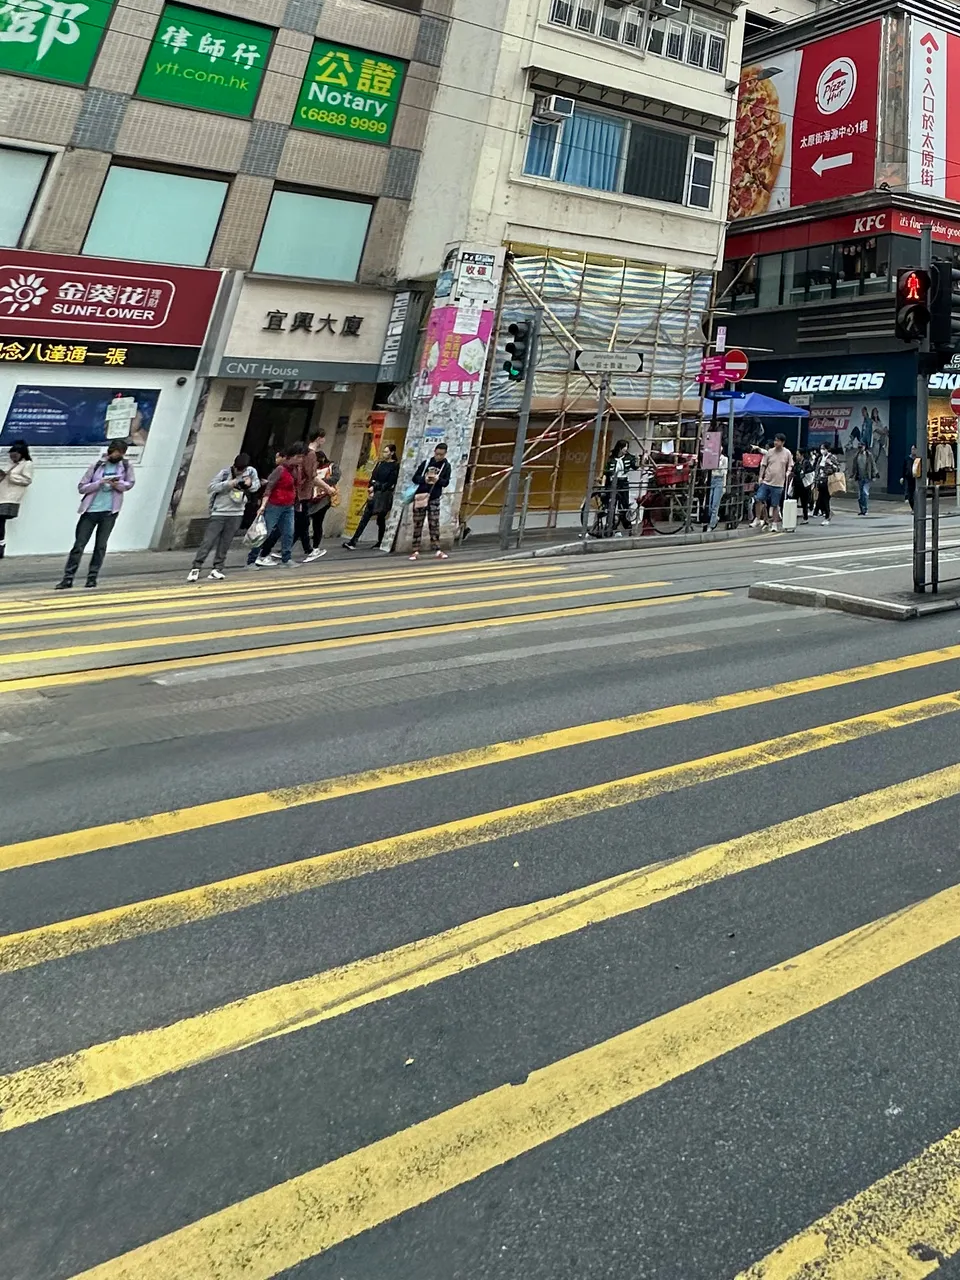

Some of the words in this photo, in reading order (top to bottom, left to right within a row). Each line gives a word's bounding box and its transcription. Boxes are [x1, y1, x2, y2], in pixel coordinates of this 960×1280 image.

[161, 25, 261, 70] 律師行
[155, 61, 249, 91] ytt.com.hk
[315, 50, 397, 97] 公證
[308, 82, 389, 117] Notary
[823, 80, 846, 99] Pizza
[827, 88, 845, 105] Hut
[308, 108, 347, 126] 6888
[349, 116, 388, 134] 9999
[921, 78, 935, 187] 入口於太原街
[853, 214, 885, 233] KFC
[55, 282, 145, 306] 金葵花
[51, 303, 155, 321] SUNFLOWER
[226, 363, 259, 375] CNT
[261, 365, 299, 376] House
[783, 373, 885, 392] SKECHERS
[811, 408, 850, 416] SKECHERS
